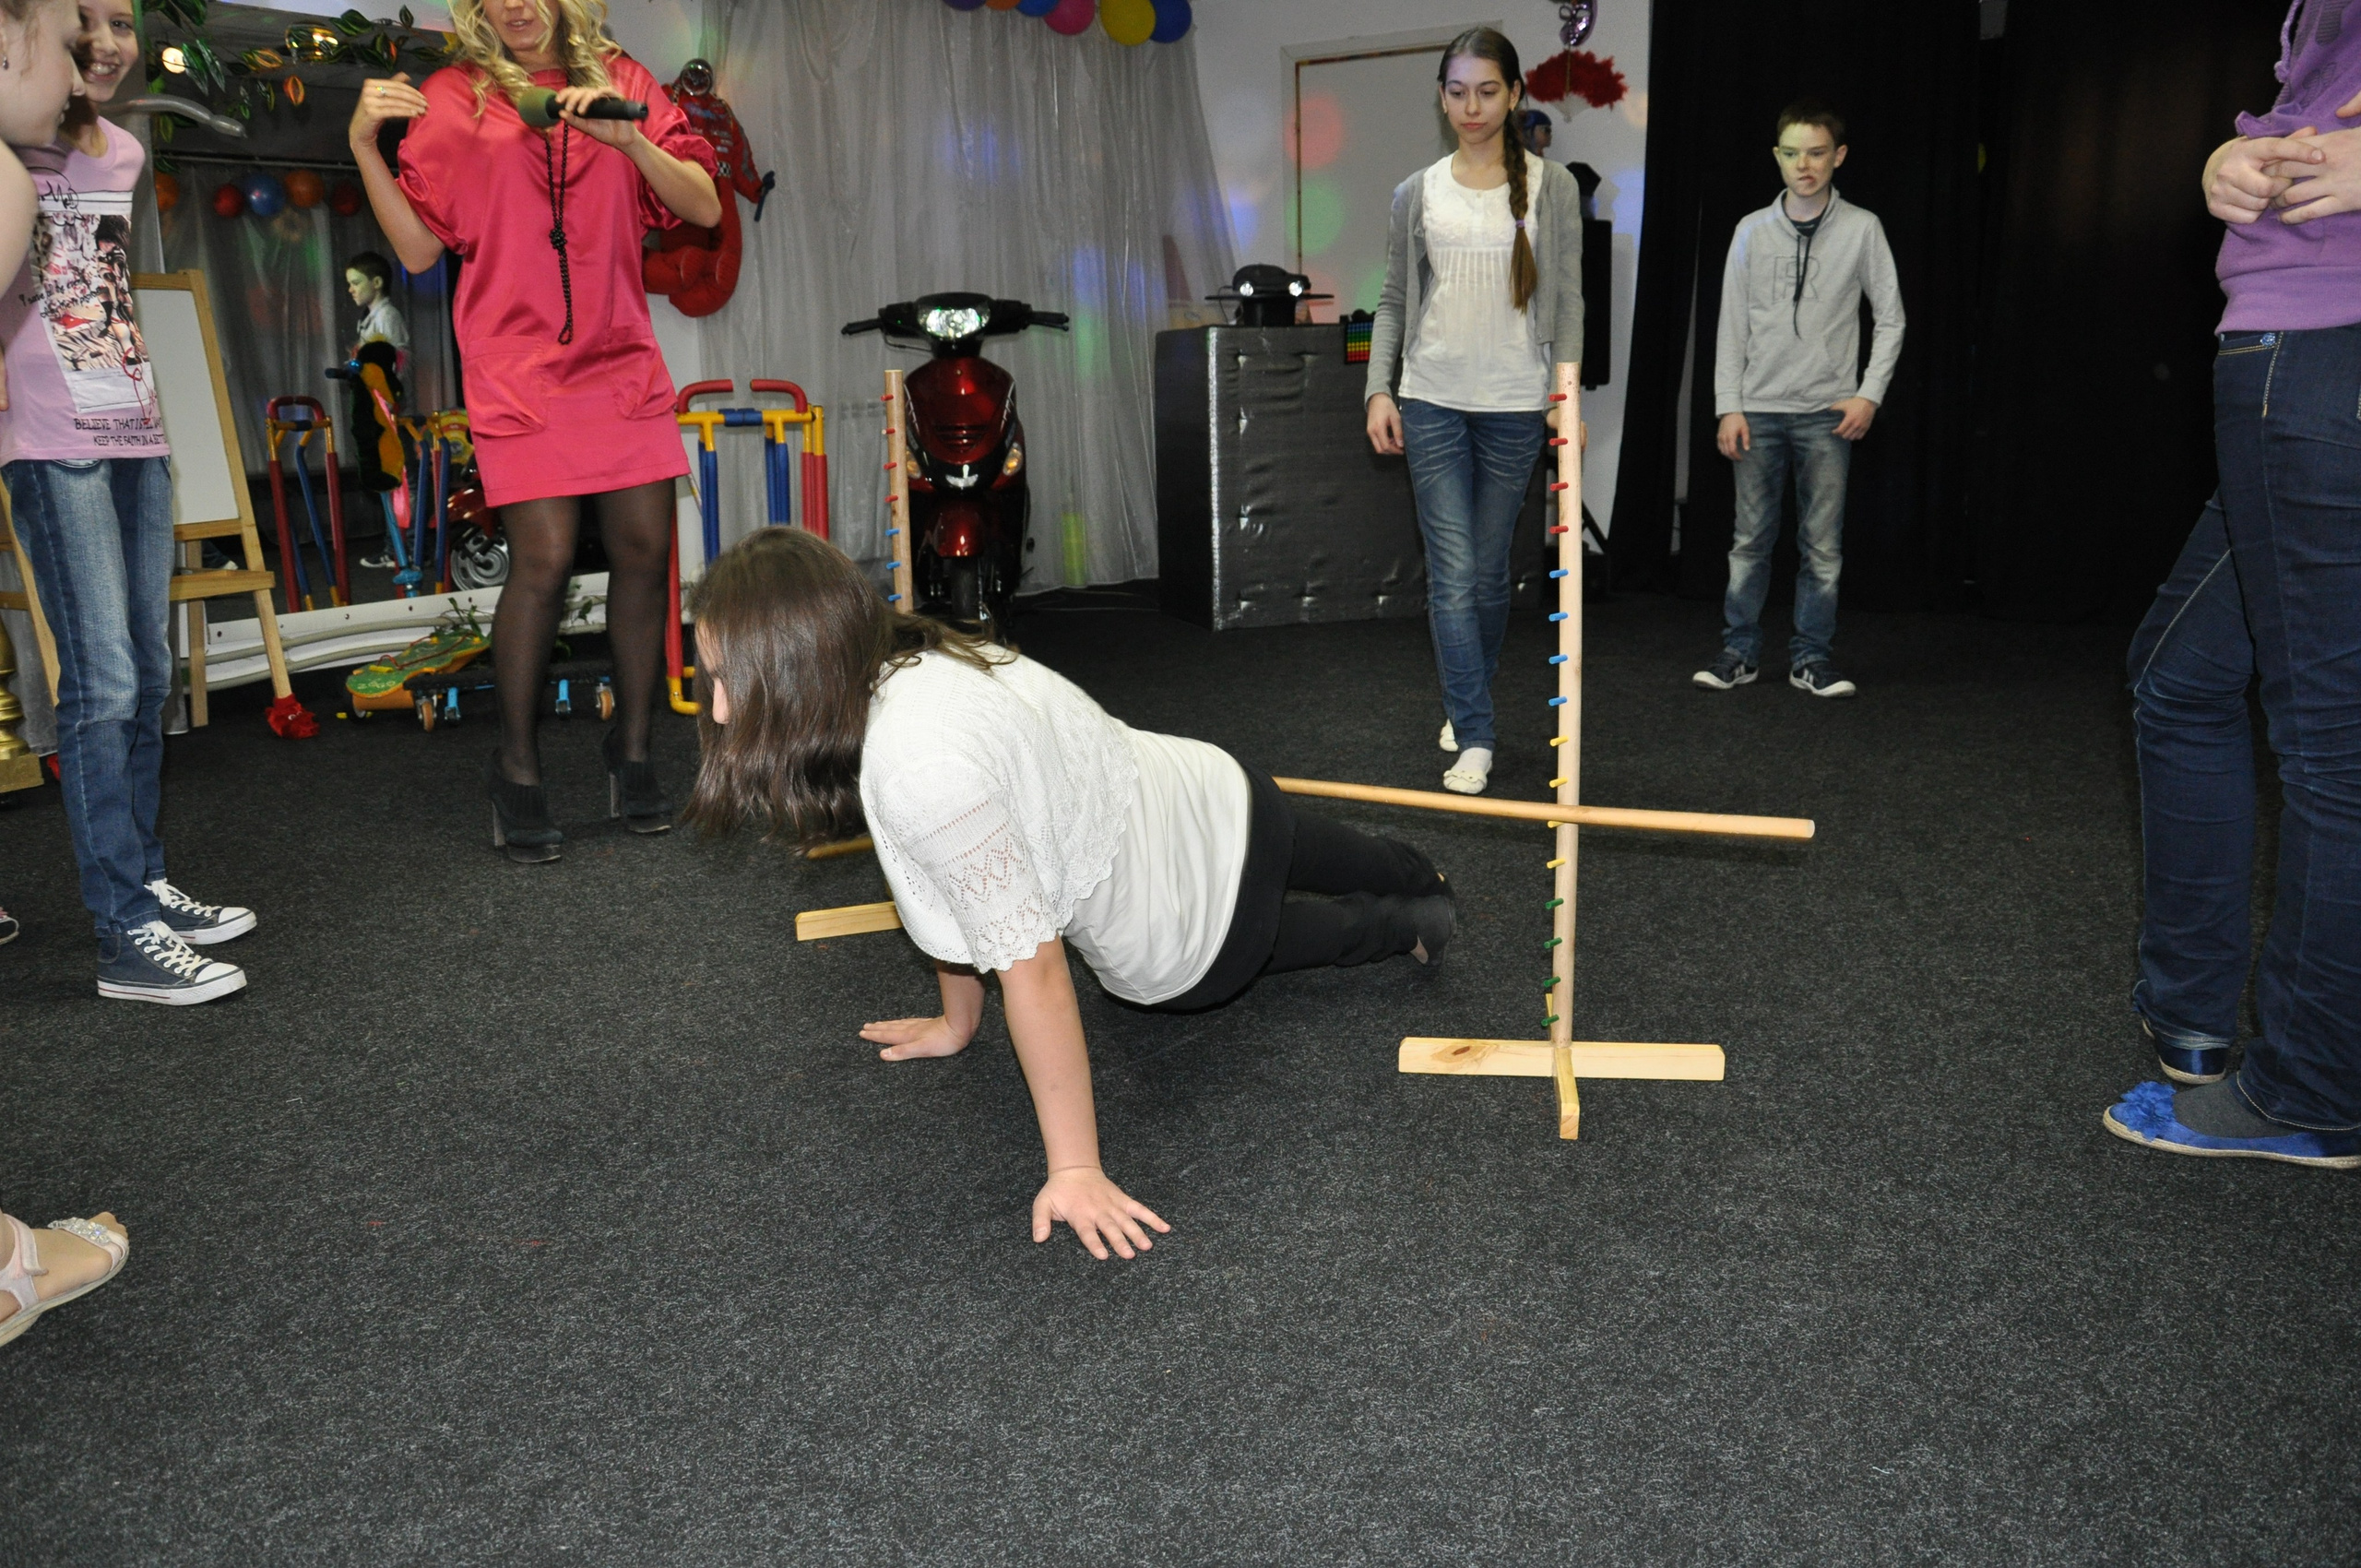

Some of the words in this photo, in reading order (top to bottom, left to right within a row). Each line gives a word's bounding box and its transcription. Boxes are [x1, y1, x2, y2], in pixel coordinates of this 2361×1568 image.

[74, 419, 111, 431] BELIEVE
[113, 419, 135, 431] THAT
[93, 435, 110, 446] KEEP
[111, 435, 124, 446] THE
